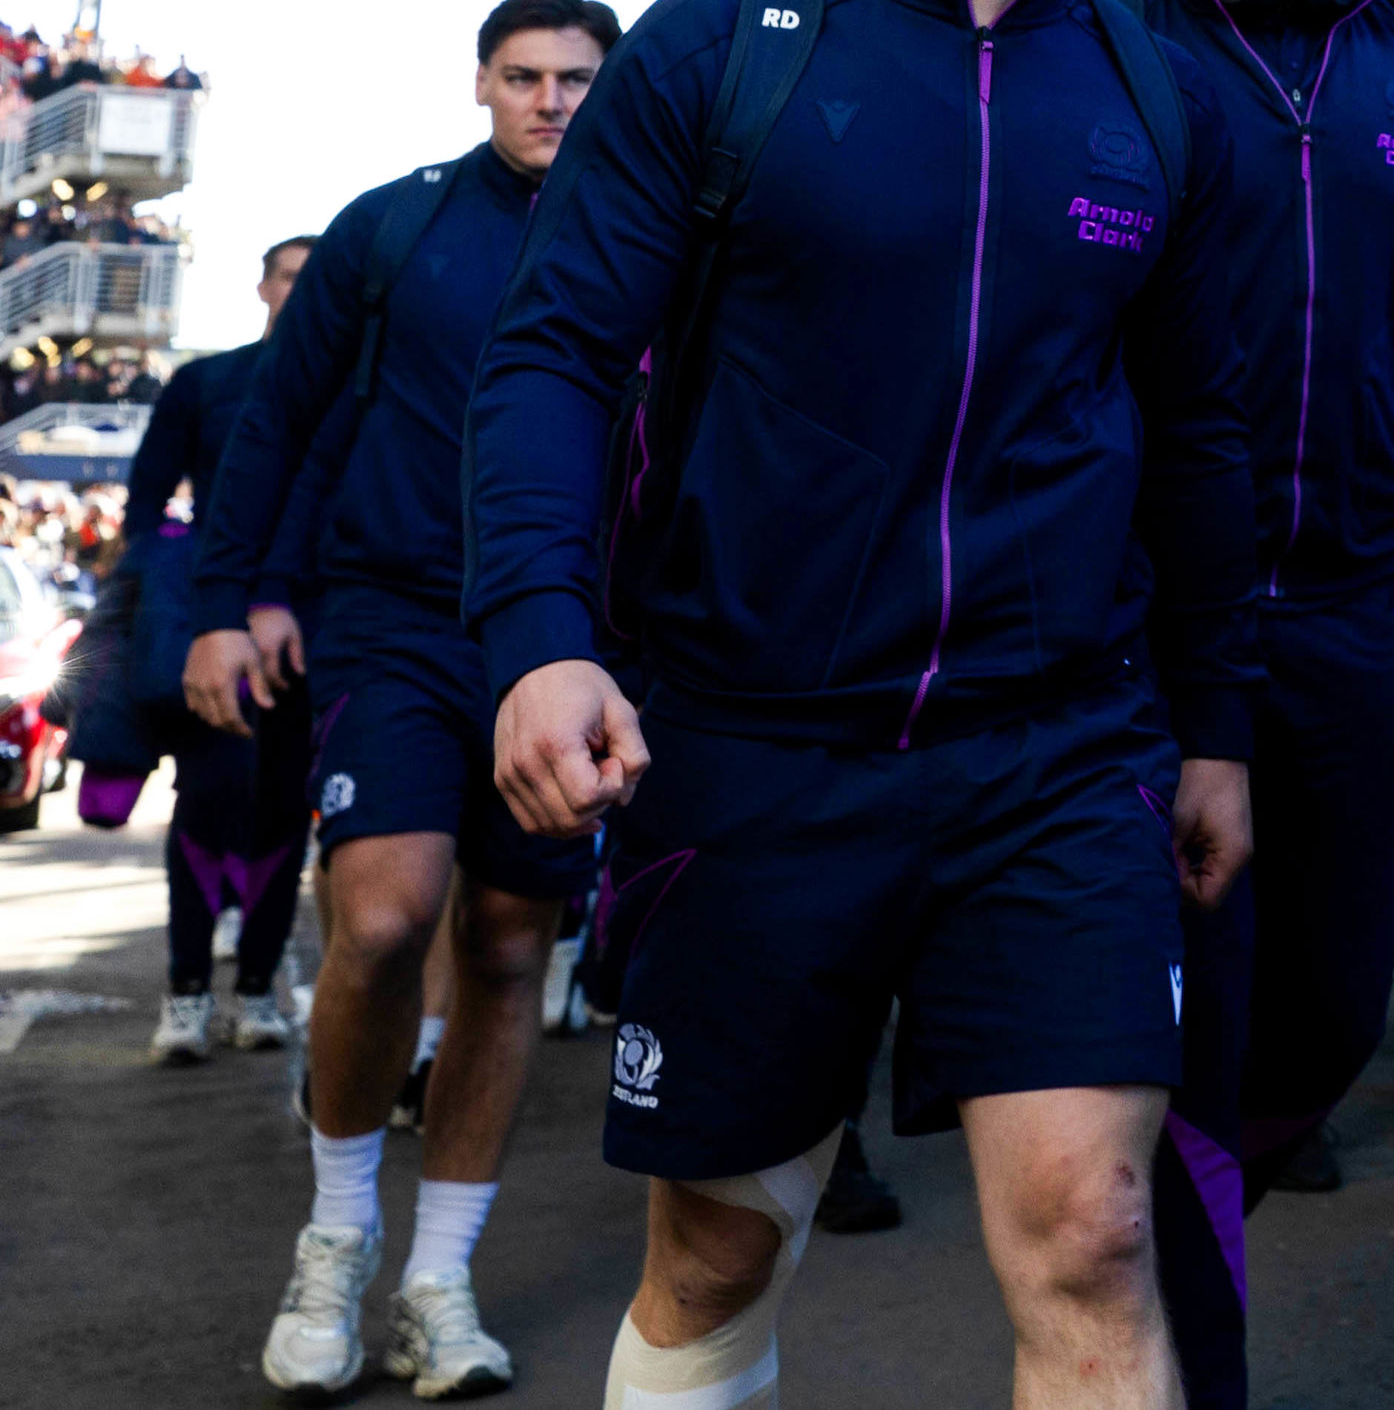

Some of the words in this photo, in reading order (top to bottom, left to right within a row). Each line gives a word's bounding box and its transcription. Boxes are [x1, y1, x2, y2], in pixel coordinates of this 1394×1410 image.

[761, 7, 800, 30] RD
[1068, 197, 1155, 232] Arnold
[1078, 220, 1144, 253] Clark
